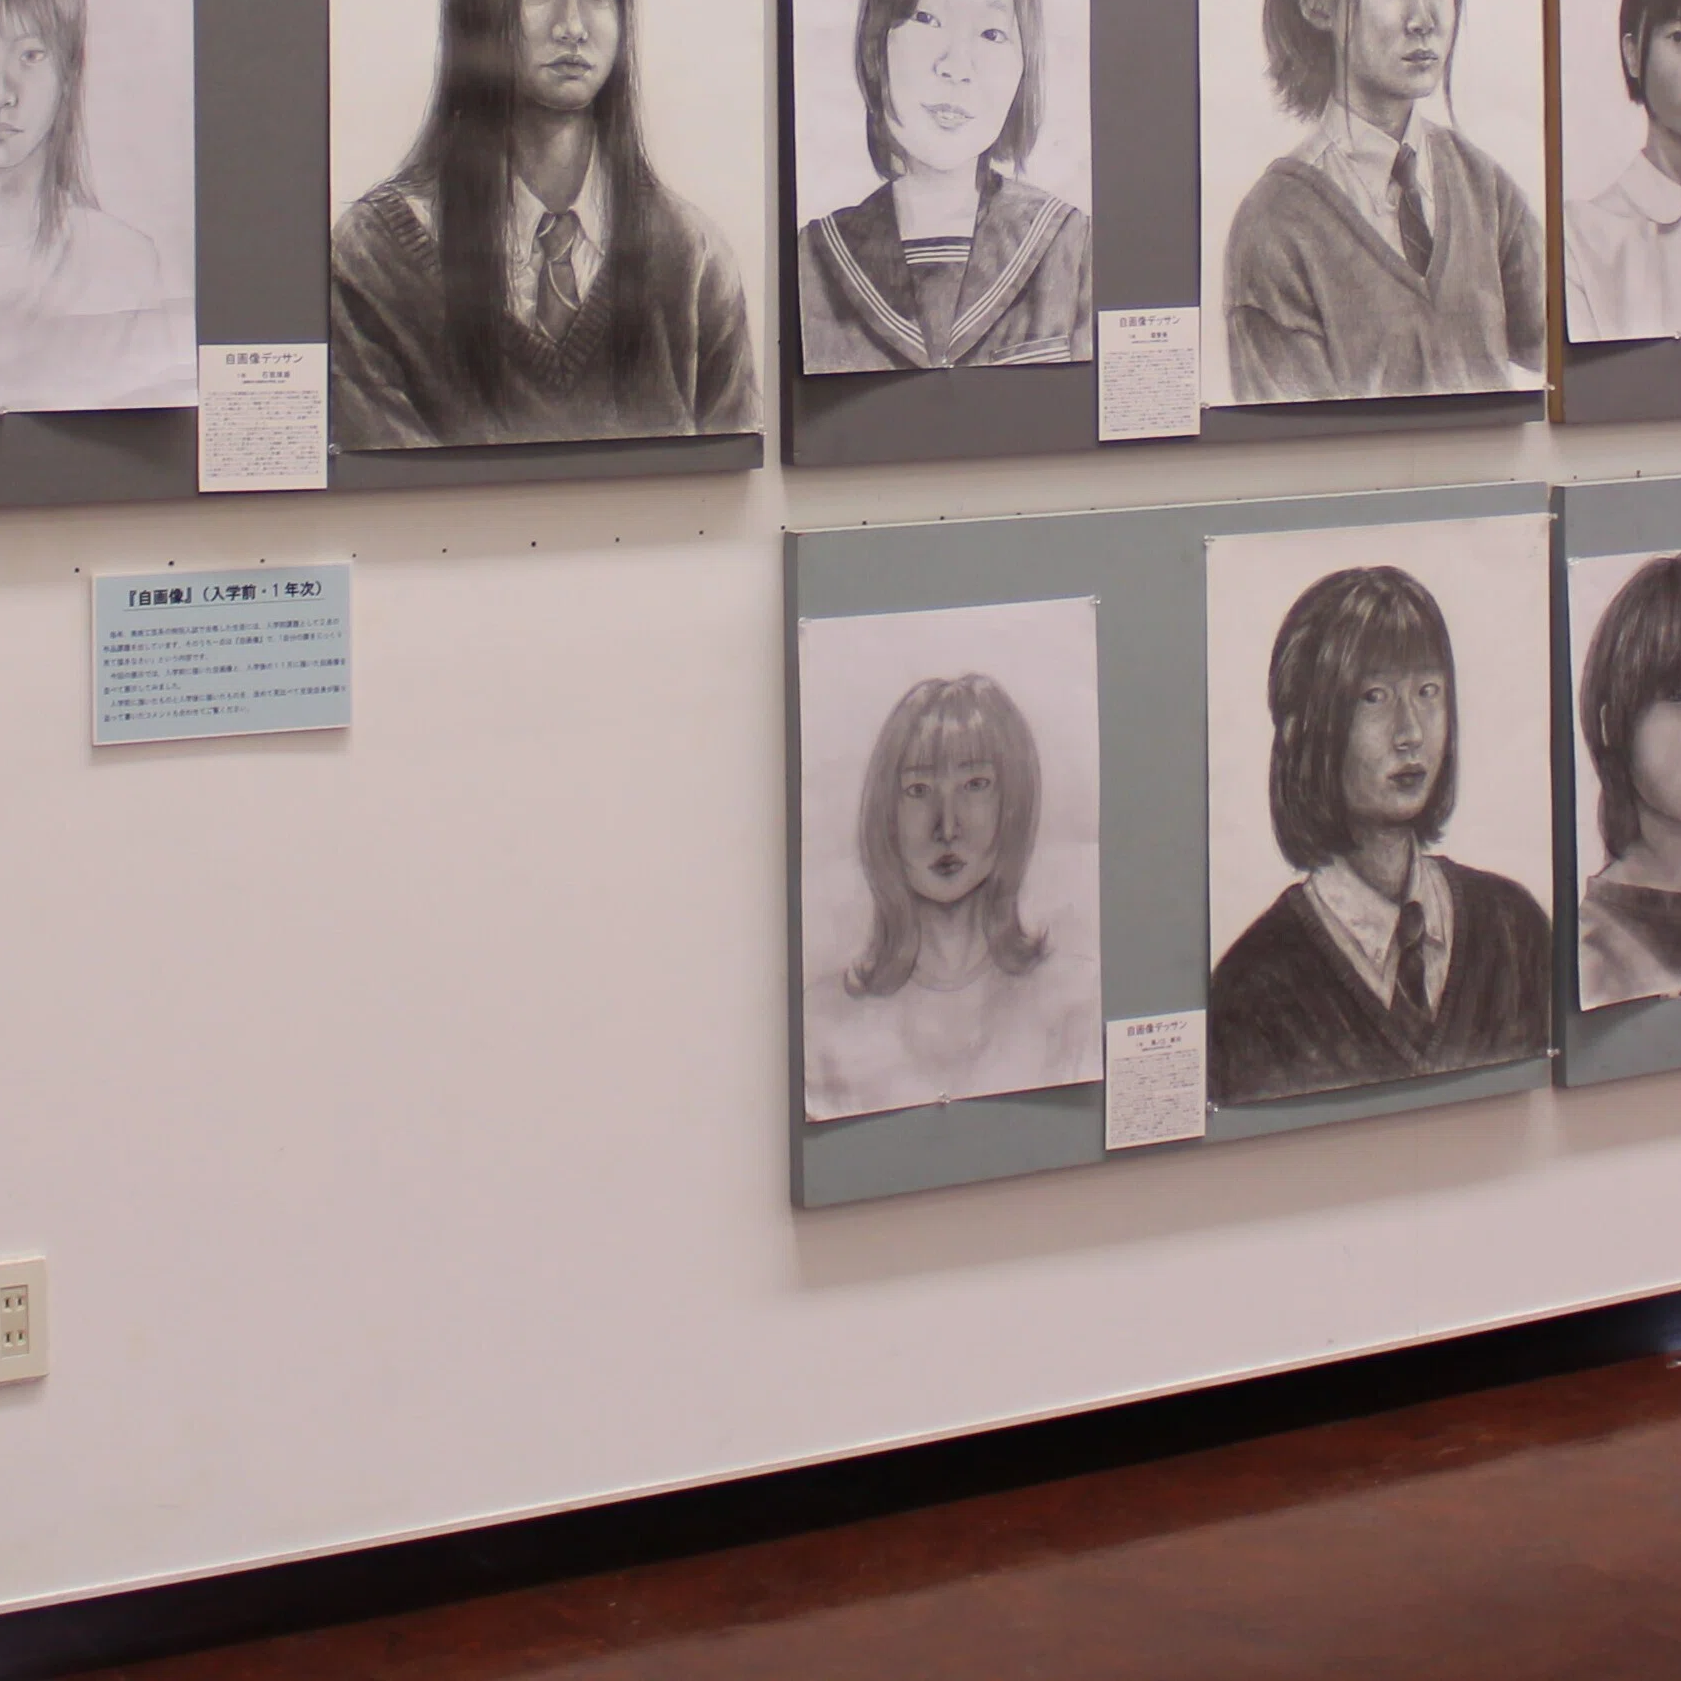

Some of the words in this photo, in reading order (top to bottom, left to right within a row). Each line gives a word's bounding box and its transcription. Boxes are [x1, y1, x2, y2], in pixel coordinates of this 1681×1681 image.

[225, 353, 304, 366] 自画像デッサン
